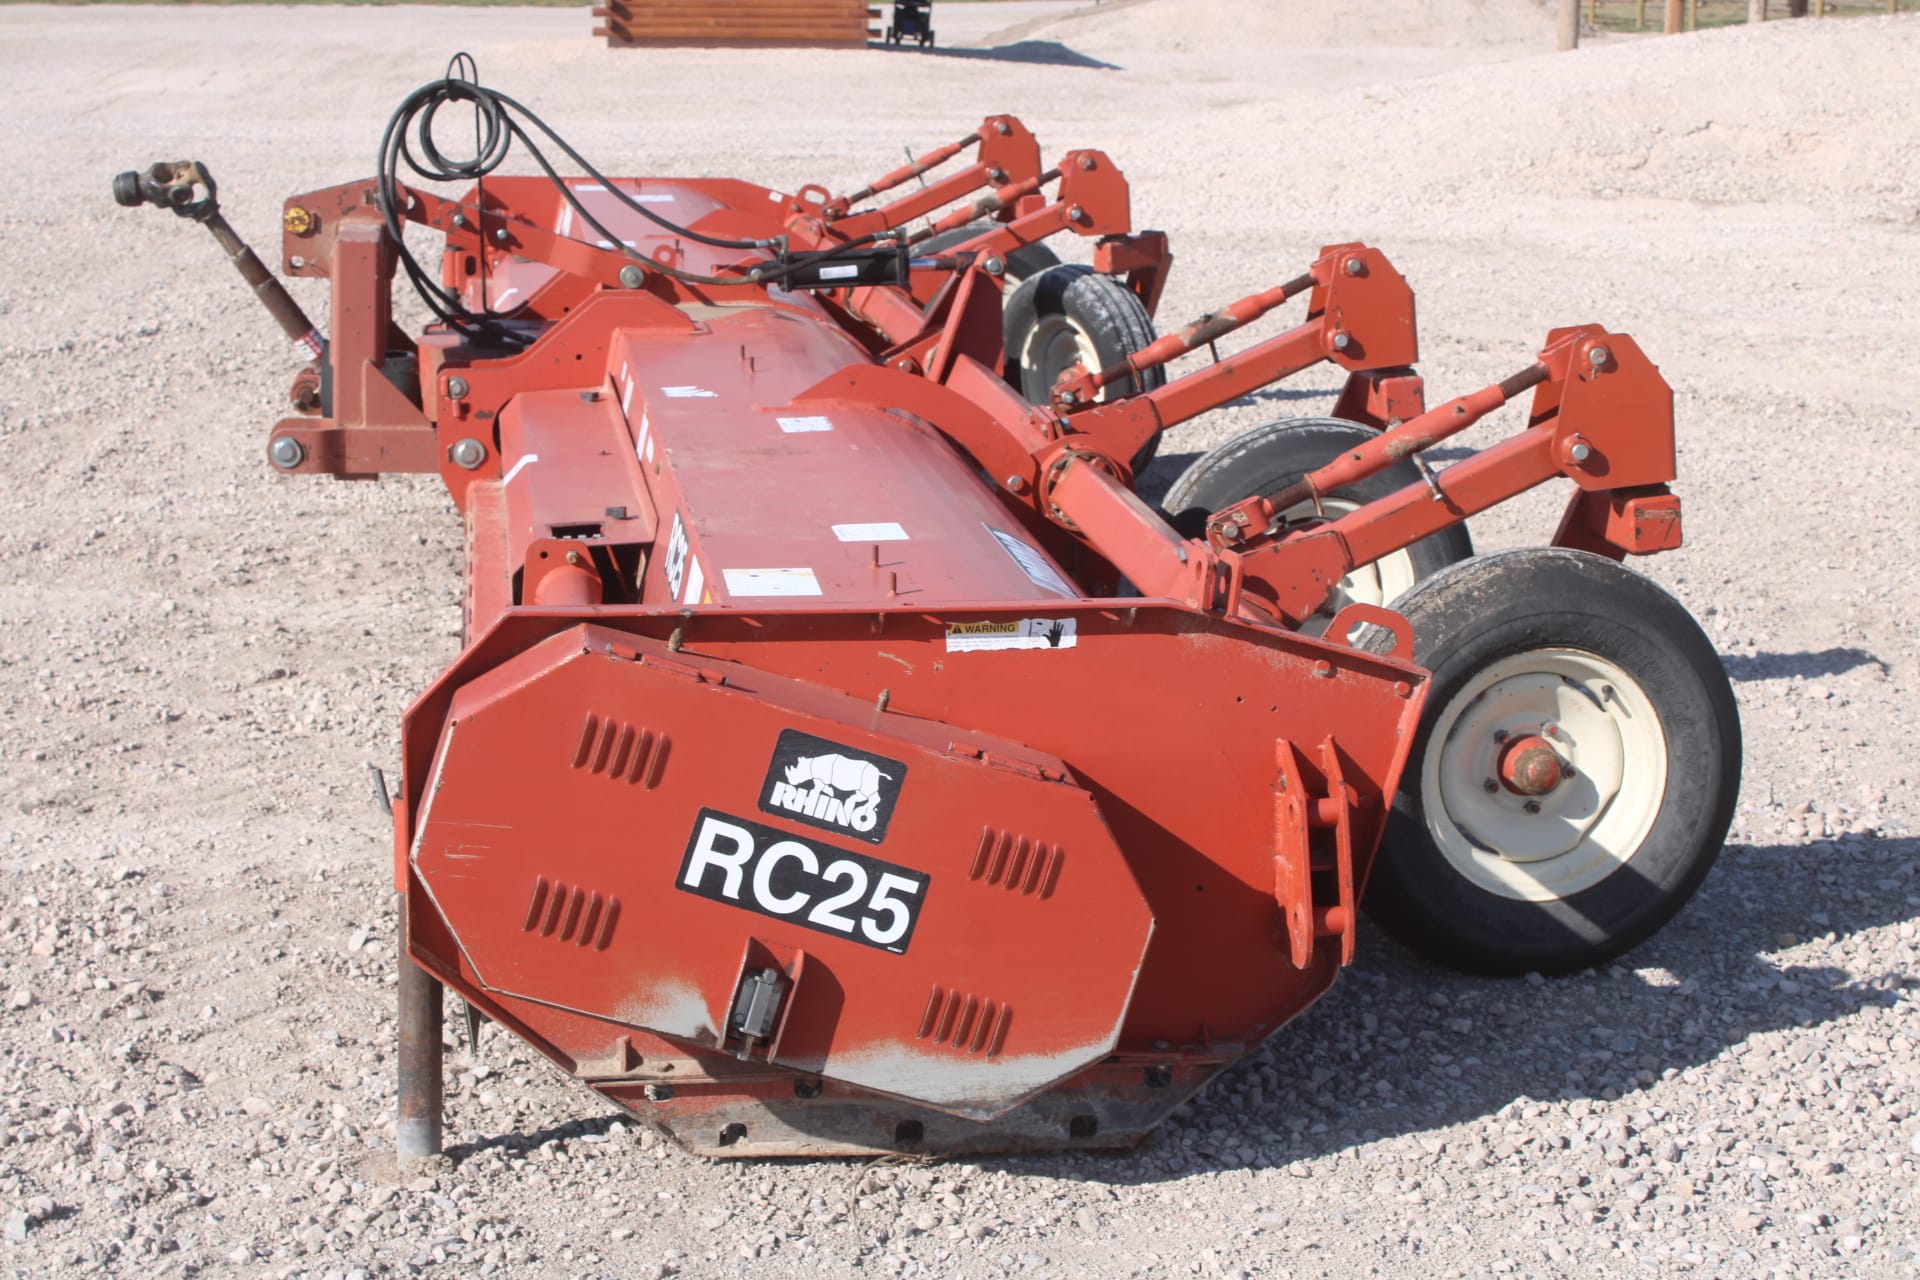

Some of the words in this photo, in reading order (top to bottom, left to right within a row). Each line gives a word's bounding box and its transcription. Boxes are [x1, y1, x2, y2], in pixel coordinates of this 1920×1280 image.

[965, 623, 1016, 634] WARNING
[769, 780, 878, 832] RHINO
[683, 816, 920, 945] RC25
